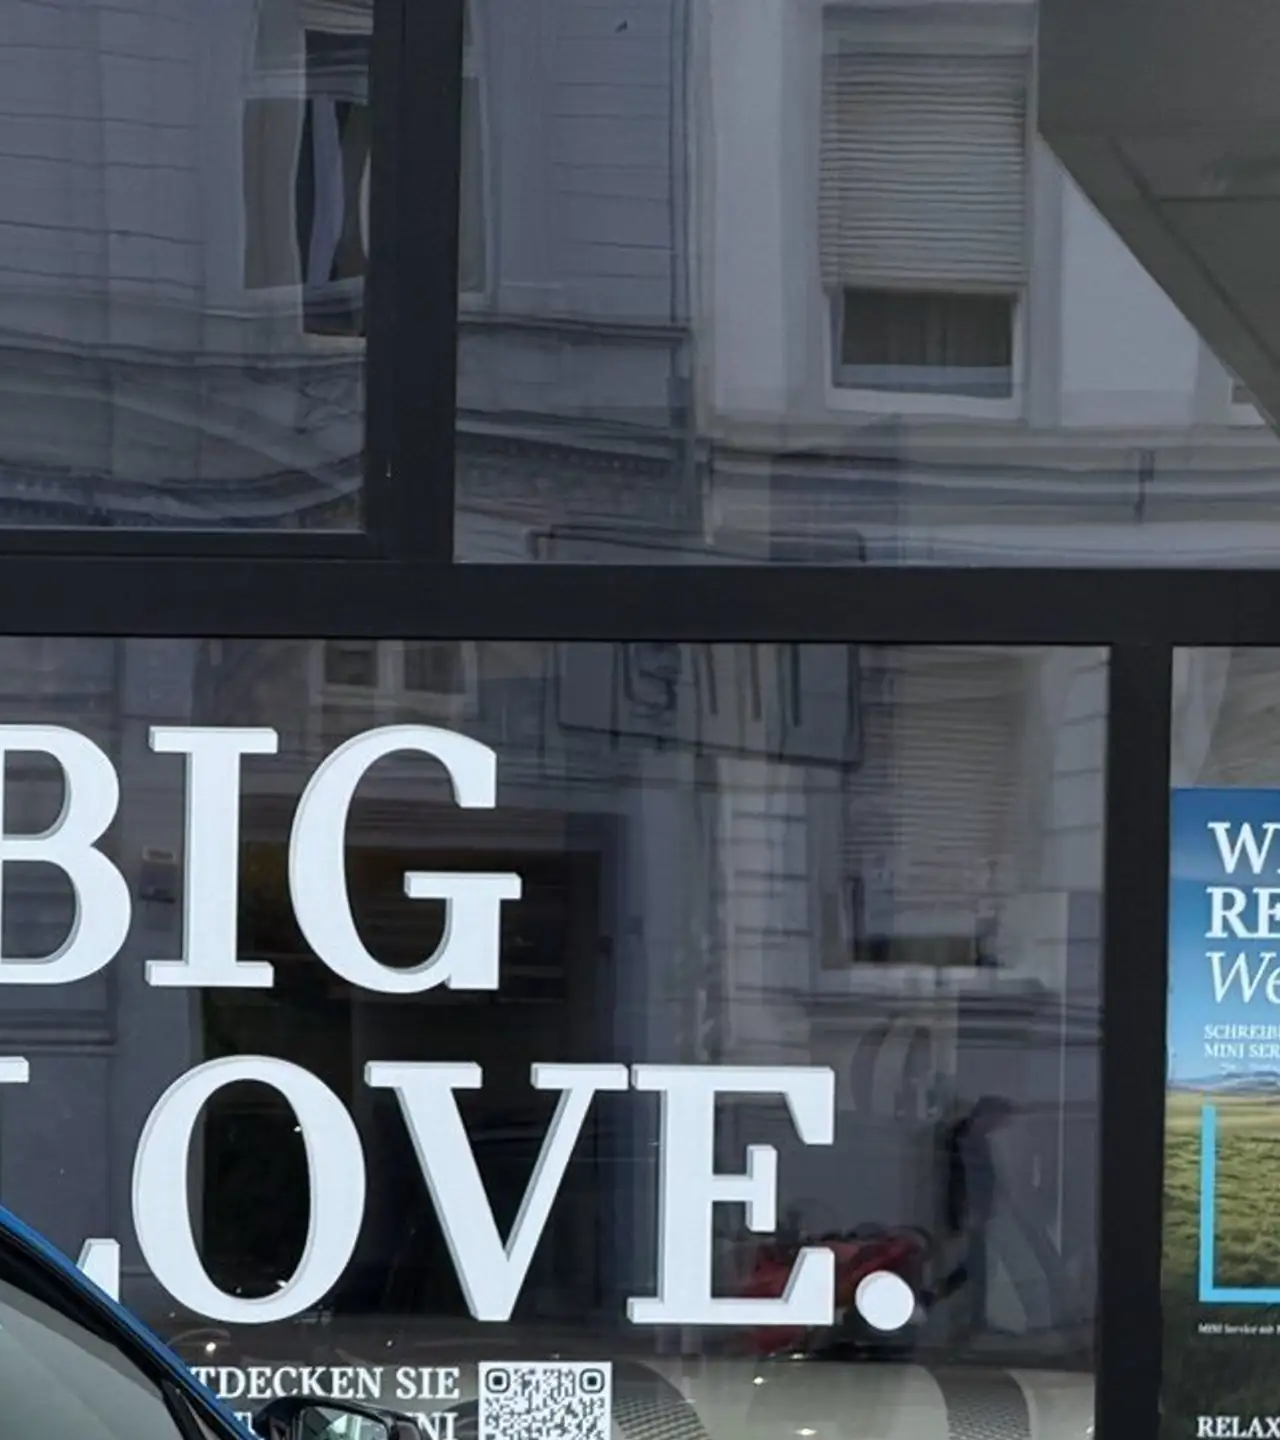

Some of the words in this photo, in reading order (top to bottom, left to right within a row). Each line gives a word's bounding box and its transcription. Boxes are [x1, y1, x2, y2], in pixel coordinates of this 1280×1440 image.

[1207, 821, 1280, 875] W
[190, 1366, 384, 1400] TDECKEN
[394, 1366, 461, 1400] SIE
